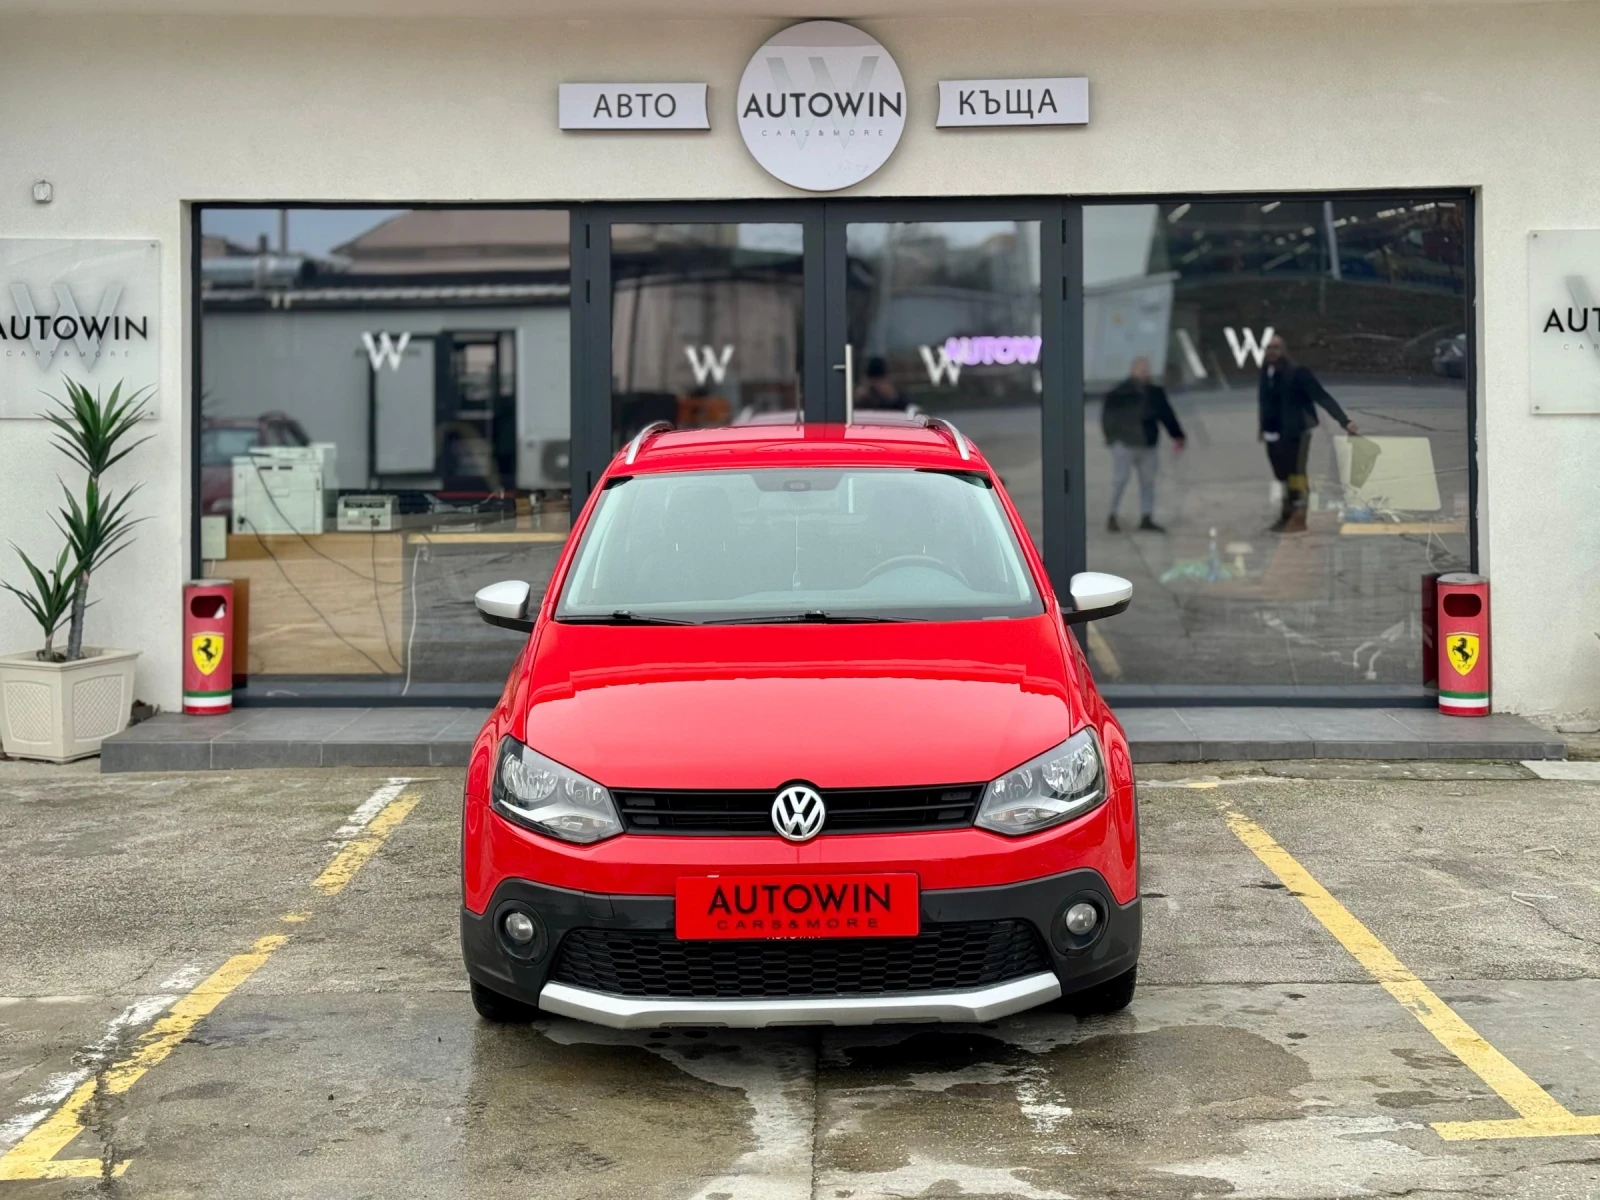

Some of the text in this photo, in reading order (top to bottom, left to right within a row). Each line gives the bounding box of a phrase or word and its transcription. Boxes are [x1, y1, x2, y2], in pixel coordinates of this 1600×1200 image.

[593, 94, 677, 119] АВТО
[743, 92, 902, 118] AUTOWIN
[958, 88, 1058, 119] КЪЩА
[707, 883, 891, 915] AUTOWIN
